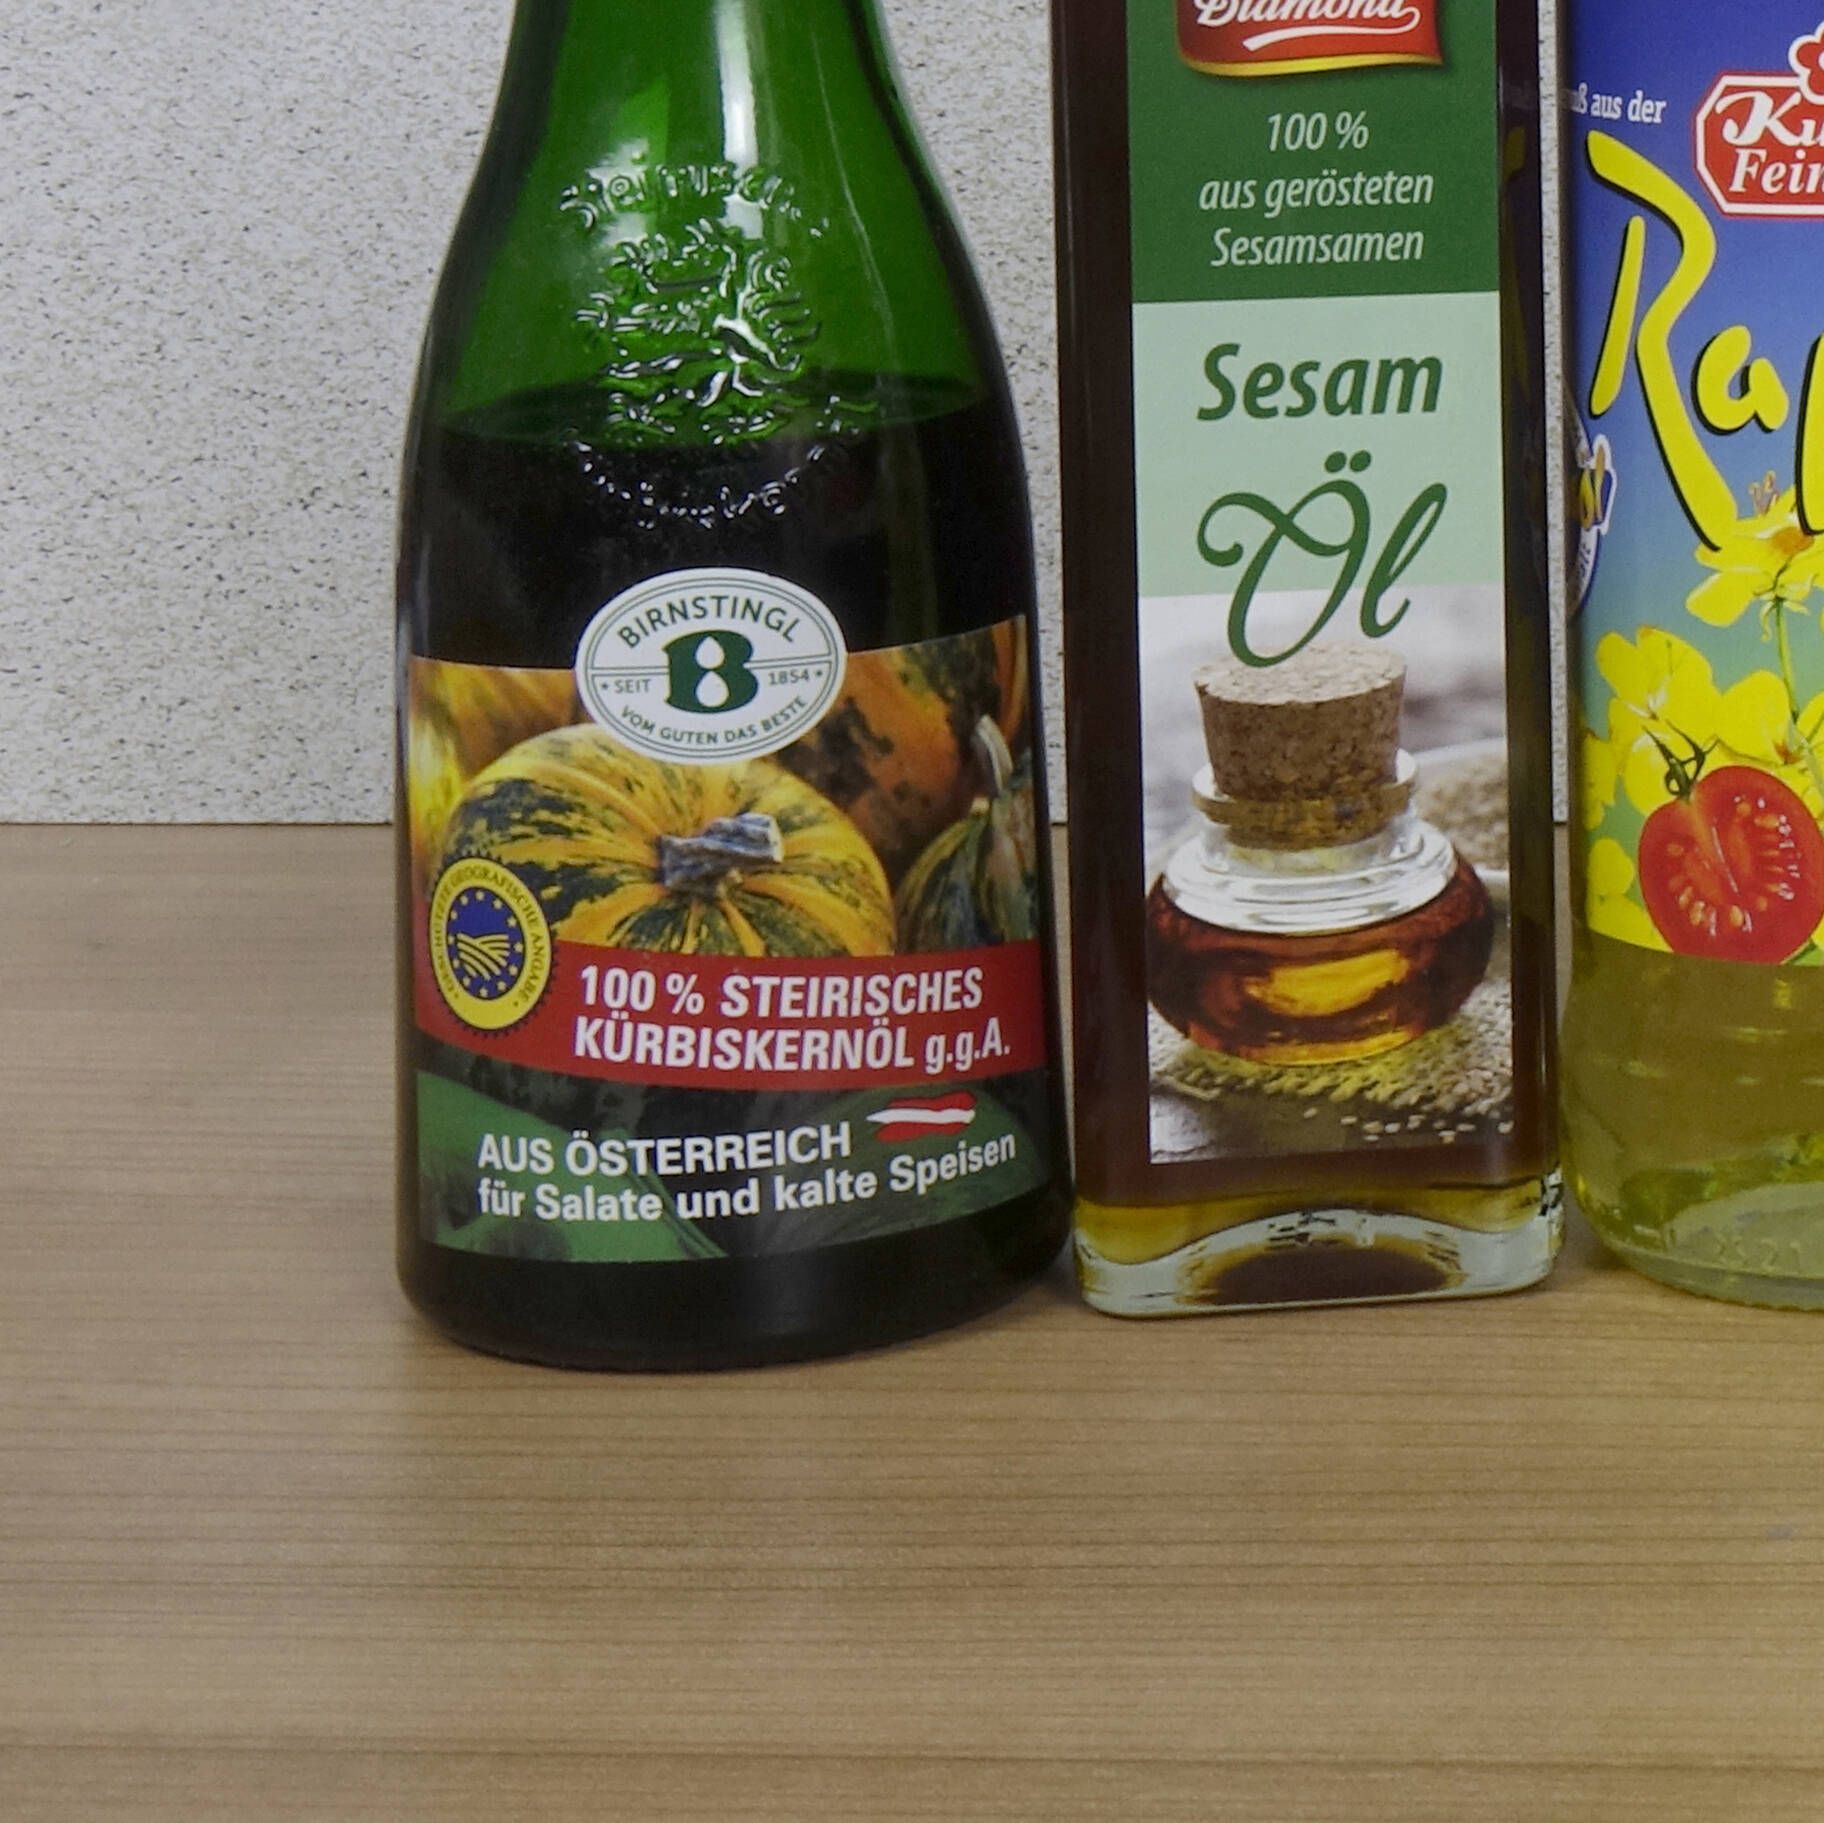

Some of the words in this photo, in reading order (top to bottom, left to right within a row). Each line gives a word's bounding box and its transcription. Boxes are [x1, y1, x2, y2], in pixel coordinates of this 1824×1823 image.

[1267, 112, 1327, 152] 100
[1335, 111, 1370, 150] %
[1591, 93, 1622, 120] aus
[1627, 89, 1667, 123] der
[1200, 179, 1256, 210] aus
[1264, 169, 1435, 218] gerösteten
[1210, 227, 1424, 267] Sesamsamen
[1197, 342, 1443, 421] Sesam
[1197, 450, 1449, 668] Öl
[617, 594, 801, 649] BIRNSTINGL
[614, 678, 651, 694] SEIT
[768, 669, 811, 686] 1854
[620, 705, 655, 733] VOM
[660, 726, 719, 745] GUTEN
[724, 725, 757, 744] DAS
[761, 696, 807, 732] BESTE
[581, 964, 656, 1013] 100
[666, 971, 706, 1016] %
[720, 966, 983, 1019] STEIRISCHES
[574, 1011, 914, 1071] KÜRBISKERNÖL
[925, 1017, 1012, 1075] g.g.A.
[478, 1132, 554, 1175] AUS
[565, 1121, 851, 1177] ÖSTERREICH
[478, 1177, 523, 1219] für
[535, 1183, 662, 1222] Salate
[676, 1179, 760, 1219] und
[774, 1168, 877, 1212] kalte
[889, 1132, 1017, 1194] Speisen
